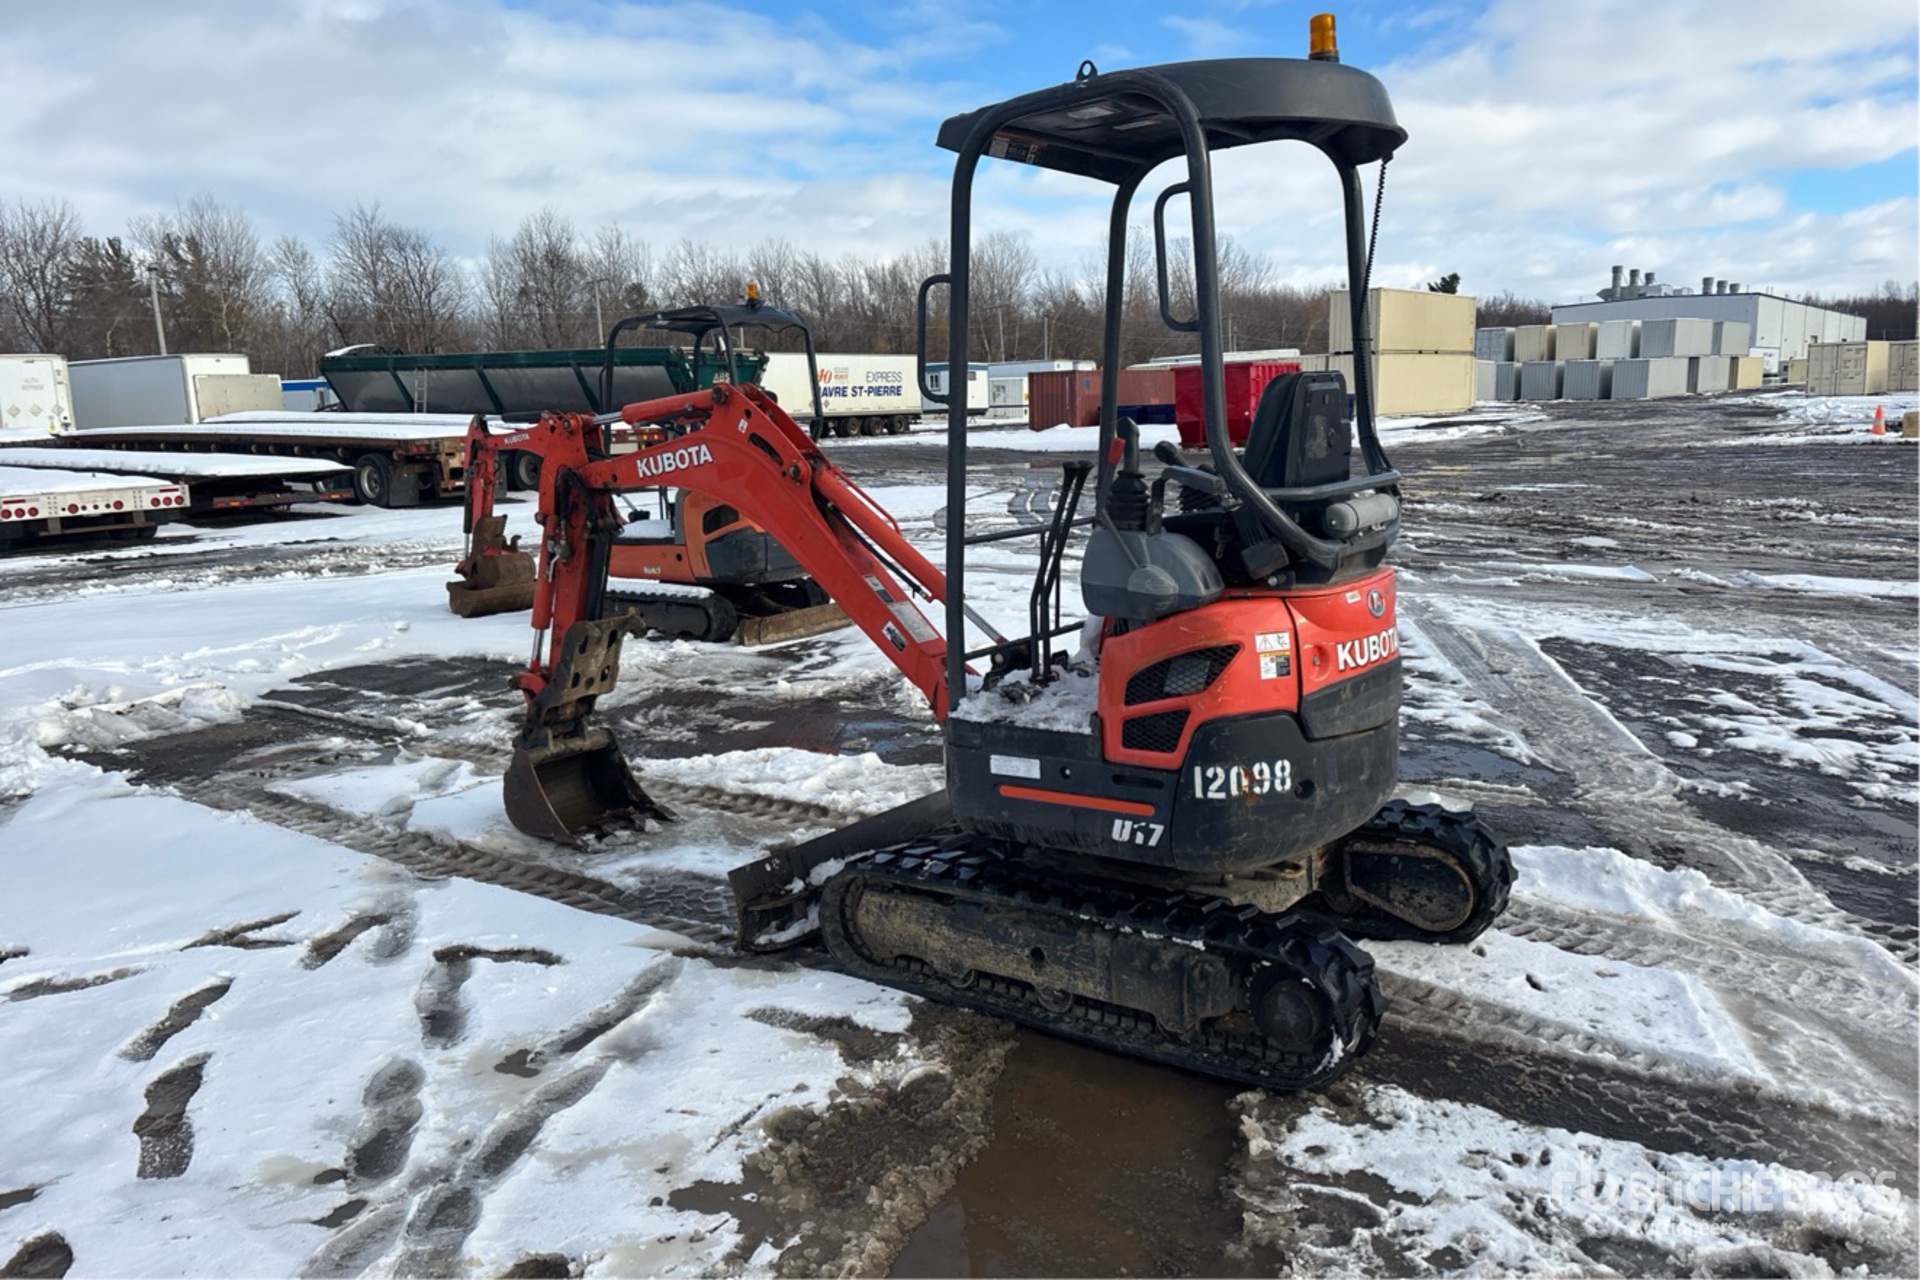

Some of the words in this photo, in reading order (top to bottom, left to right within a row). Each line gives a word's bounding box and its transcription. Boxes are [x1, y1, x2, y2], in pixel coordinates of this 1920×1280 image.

[866, 371, 902, 383] EXPRESS
[820, 386, 848, 397] AVRE
[851, 385, 902, 397] ST-PIERRE
[636, 443, 713, 478] KUBOTA
[1194, 759, 1292, 799] 12098
